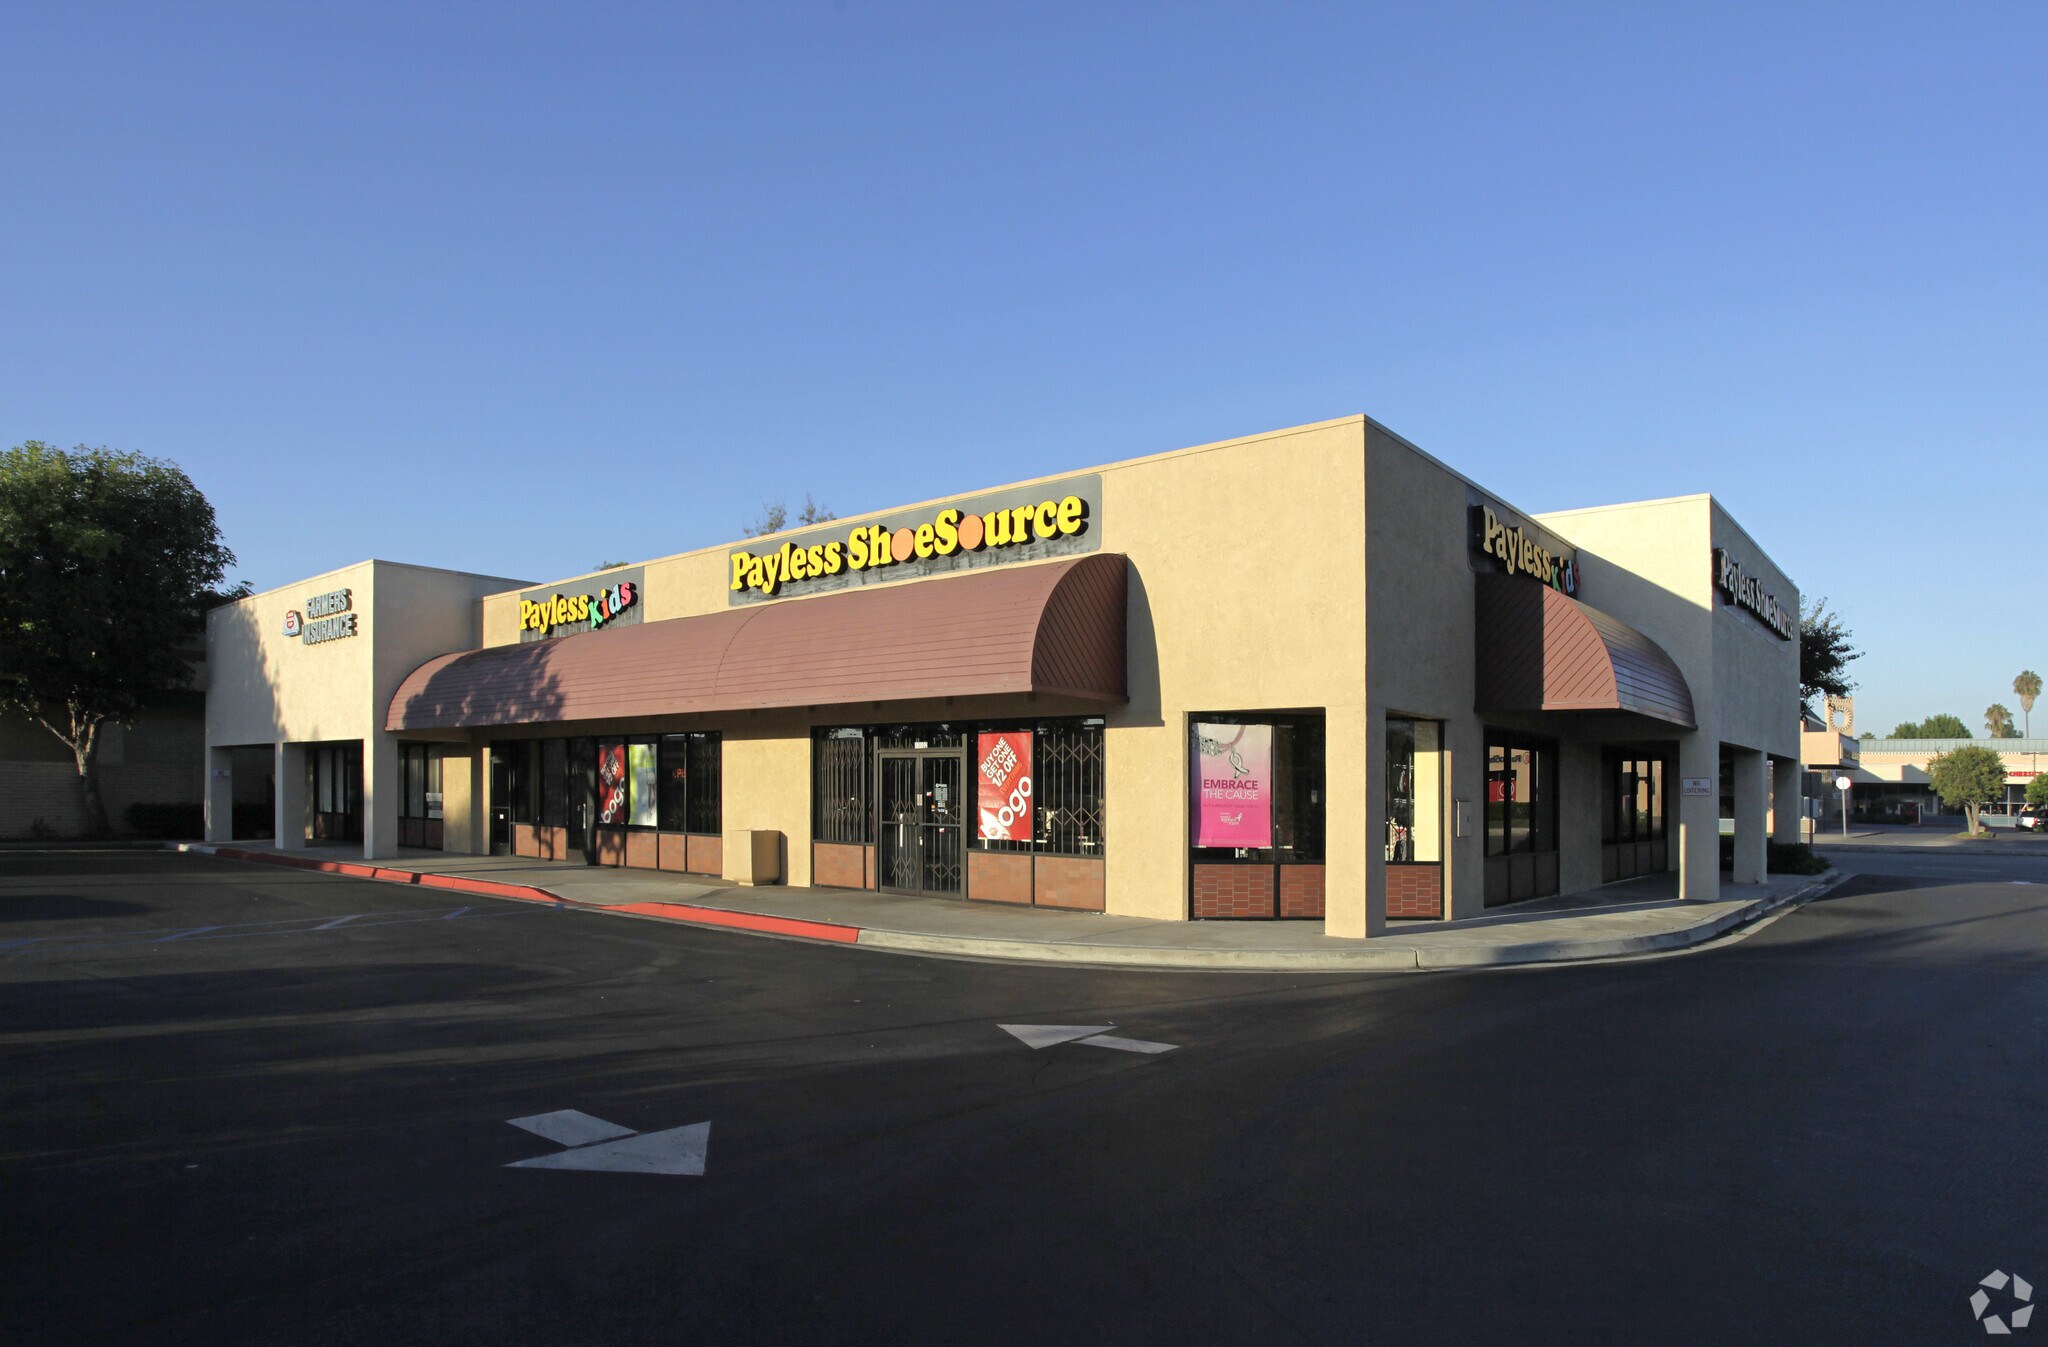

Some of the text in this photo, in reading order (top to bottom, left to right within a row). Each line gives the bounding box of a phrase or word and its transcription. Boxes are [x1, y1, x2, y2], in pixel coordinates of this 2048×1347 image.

[730, 495, 1090, 595] Payless ShoeSource
[1482, 504, 1551, 583] Payless
[1719, 548, 1755, 610] Payless
[307, 588, 352, 619] FARMERS
[519, 593, 591, 635] Payless
[302, 613, 358, 645] INSURANCE
[980, 737, 1006, 773] BUY ONE
[986, 743, 1012, 778] GET ONE
[992, 750, 1017, 787] 1/2 OFF
[1203, 779, 1259, 790] EMBRACE
[1203, 789, 1259, 800] THE CAUSE
[980, 776, 1032, 840] bogo
